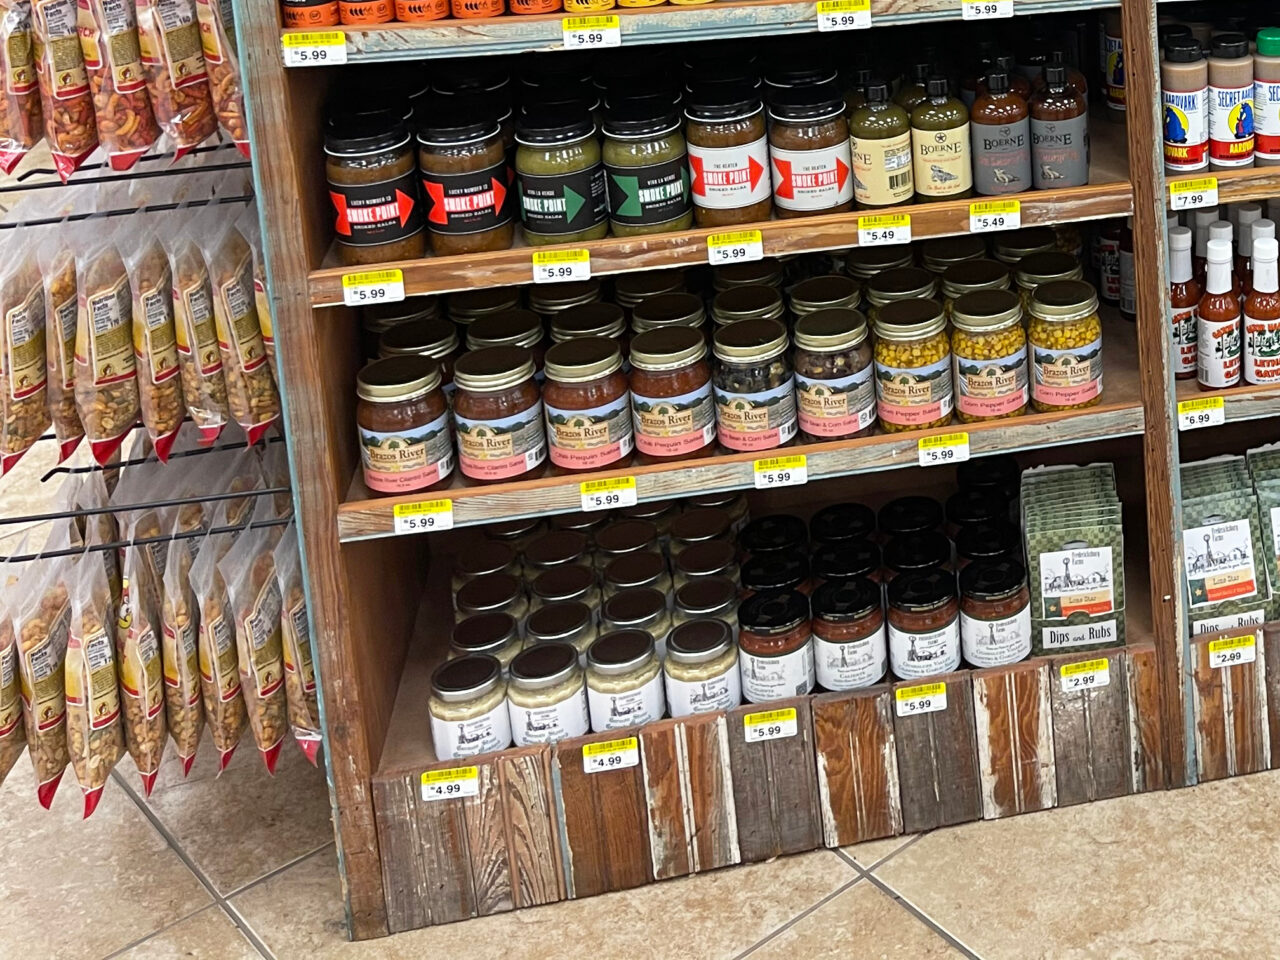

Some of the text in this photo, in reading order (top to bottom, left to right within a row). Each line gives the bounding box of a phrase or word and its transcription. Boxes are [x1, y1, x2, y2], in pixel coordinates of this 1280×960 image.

[1217, 90, 1240, 106] SECRET
[920, 142, 962, 157] BOERNE
[983, 134, 1025, 151] BOERNE
[444, 191, 495, 212] SMOKE POINT
[523, 196, 567, 212] SMOKE POINT
[968, 373, 1016, 388] Brazos River
[883, 382, 931, 395] Brazos River
[1056, 388, 1080, 398] Pepper
